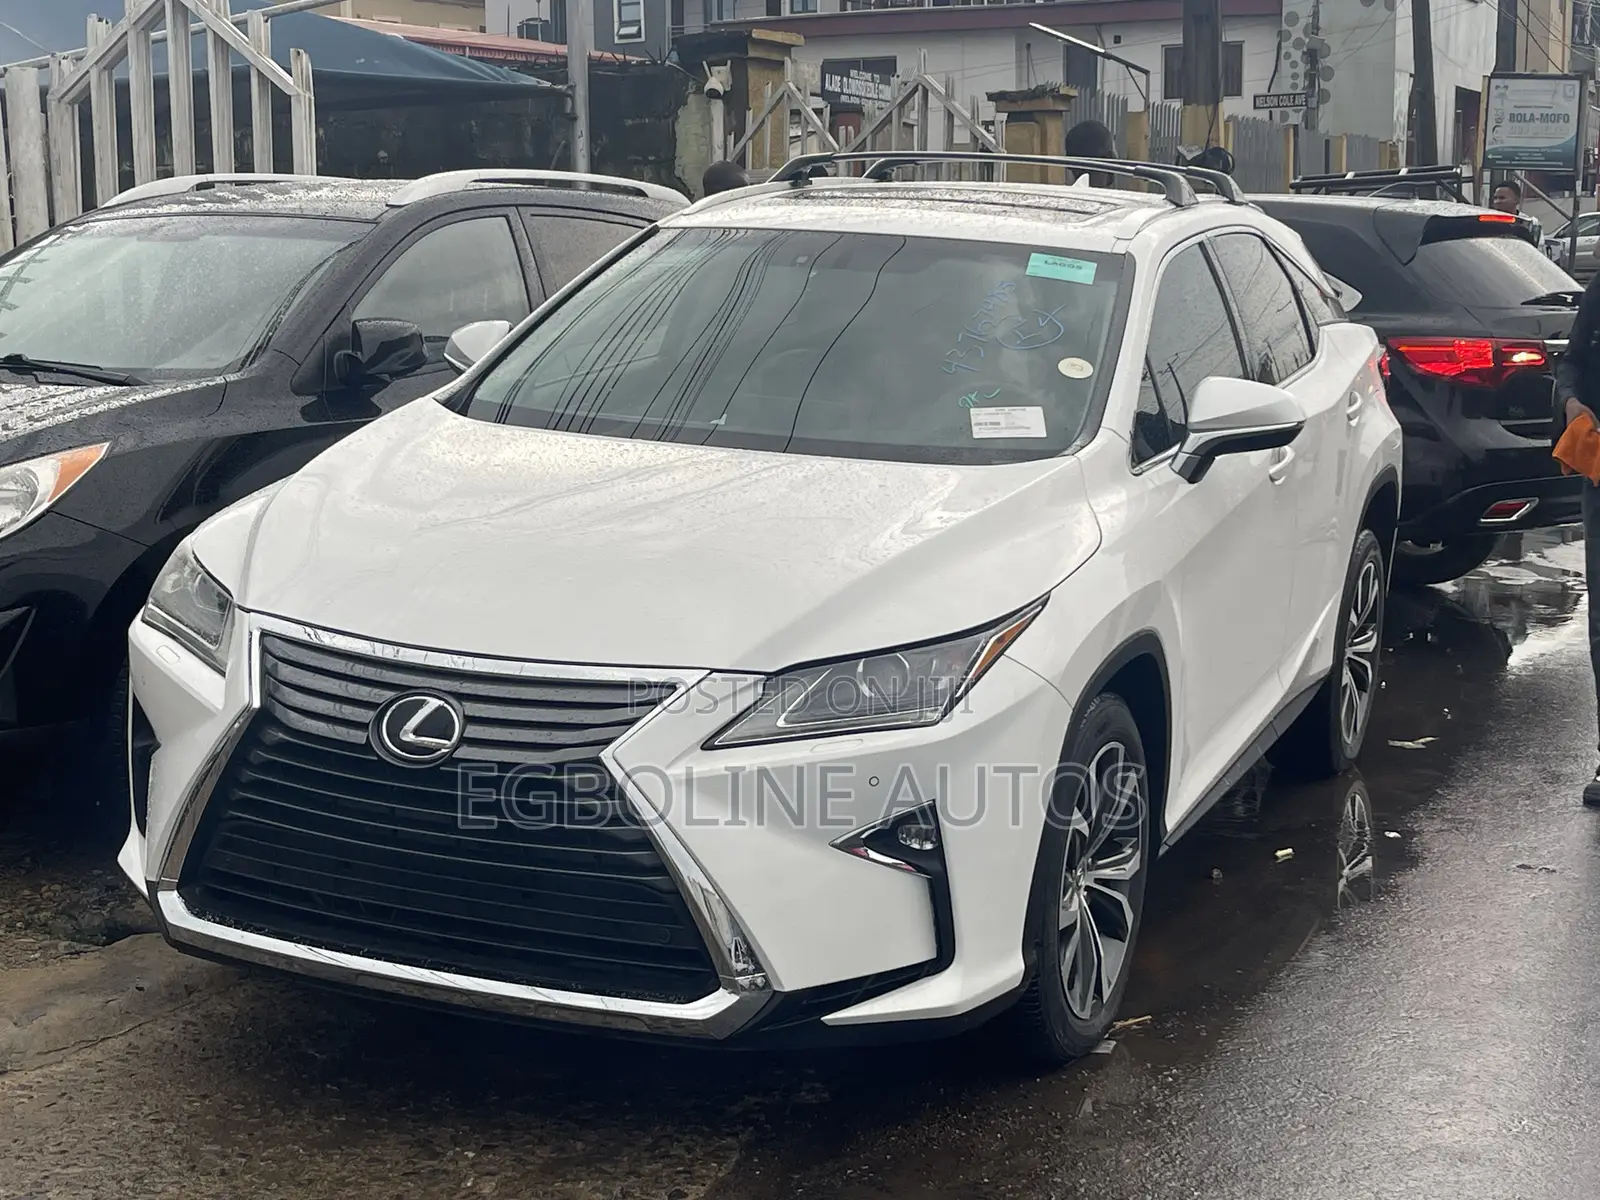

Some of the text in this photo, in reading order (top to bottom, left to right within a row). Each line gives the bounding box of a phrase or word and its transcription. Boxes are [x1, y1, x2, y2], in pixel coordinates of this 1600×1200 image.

[1256, 96, 1279, 107] NELSON
[1279, 95, 1294, 107] COLE
[1508, 112, 1570, 124] BOLA-MOFO
